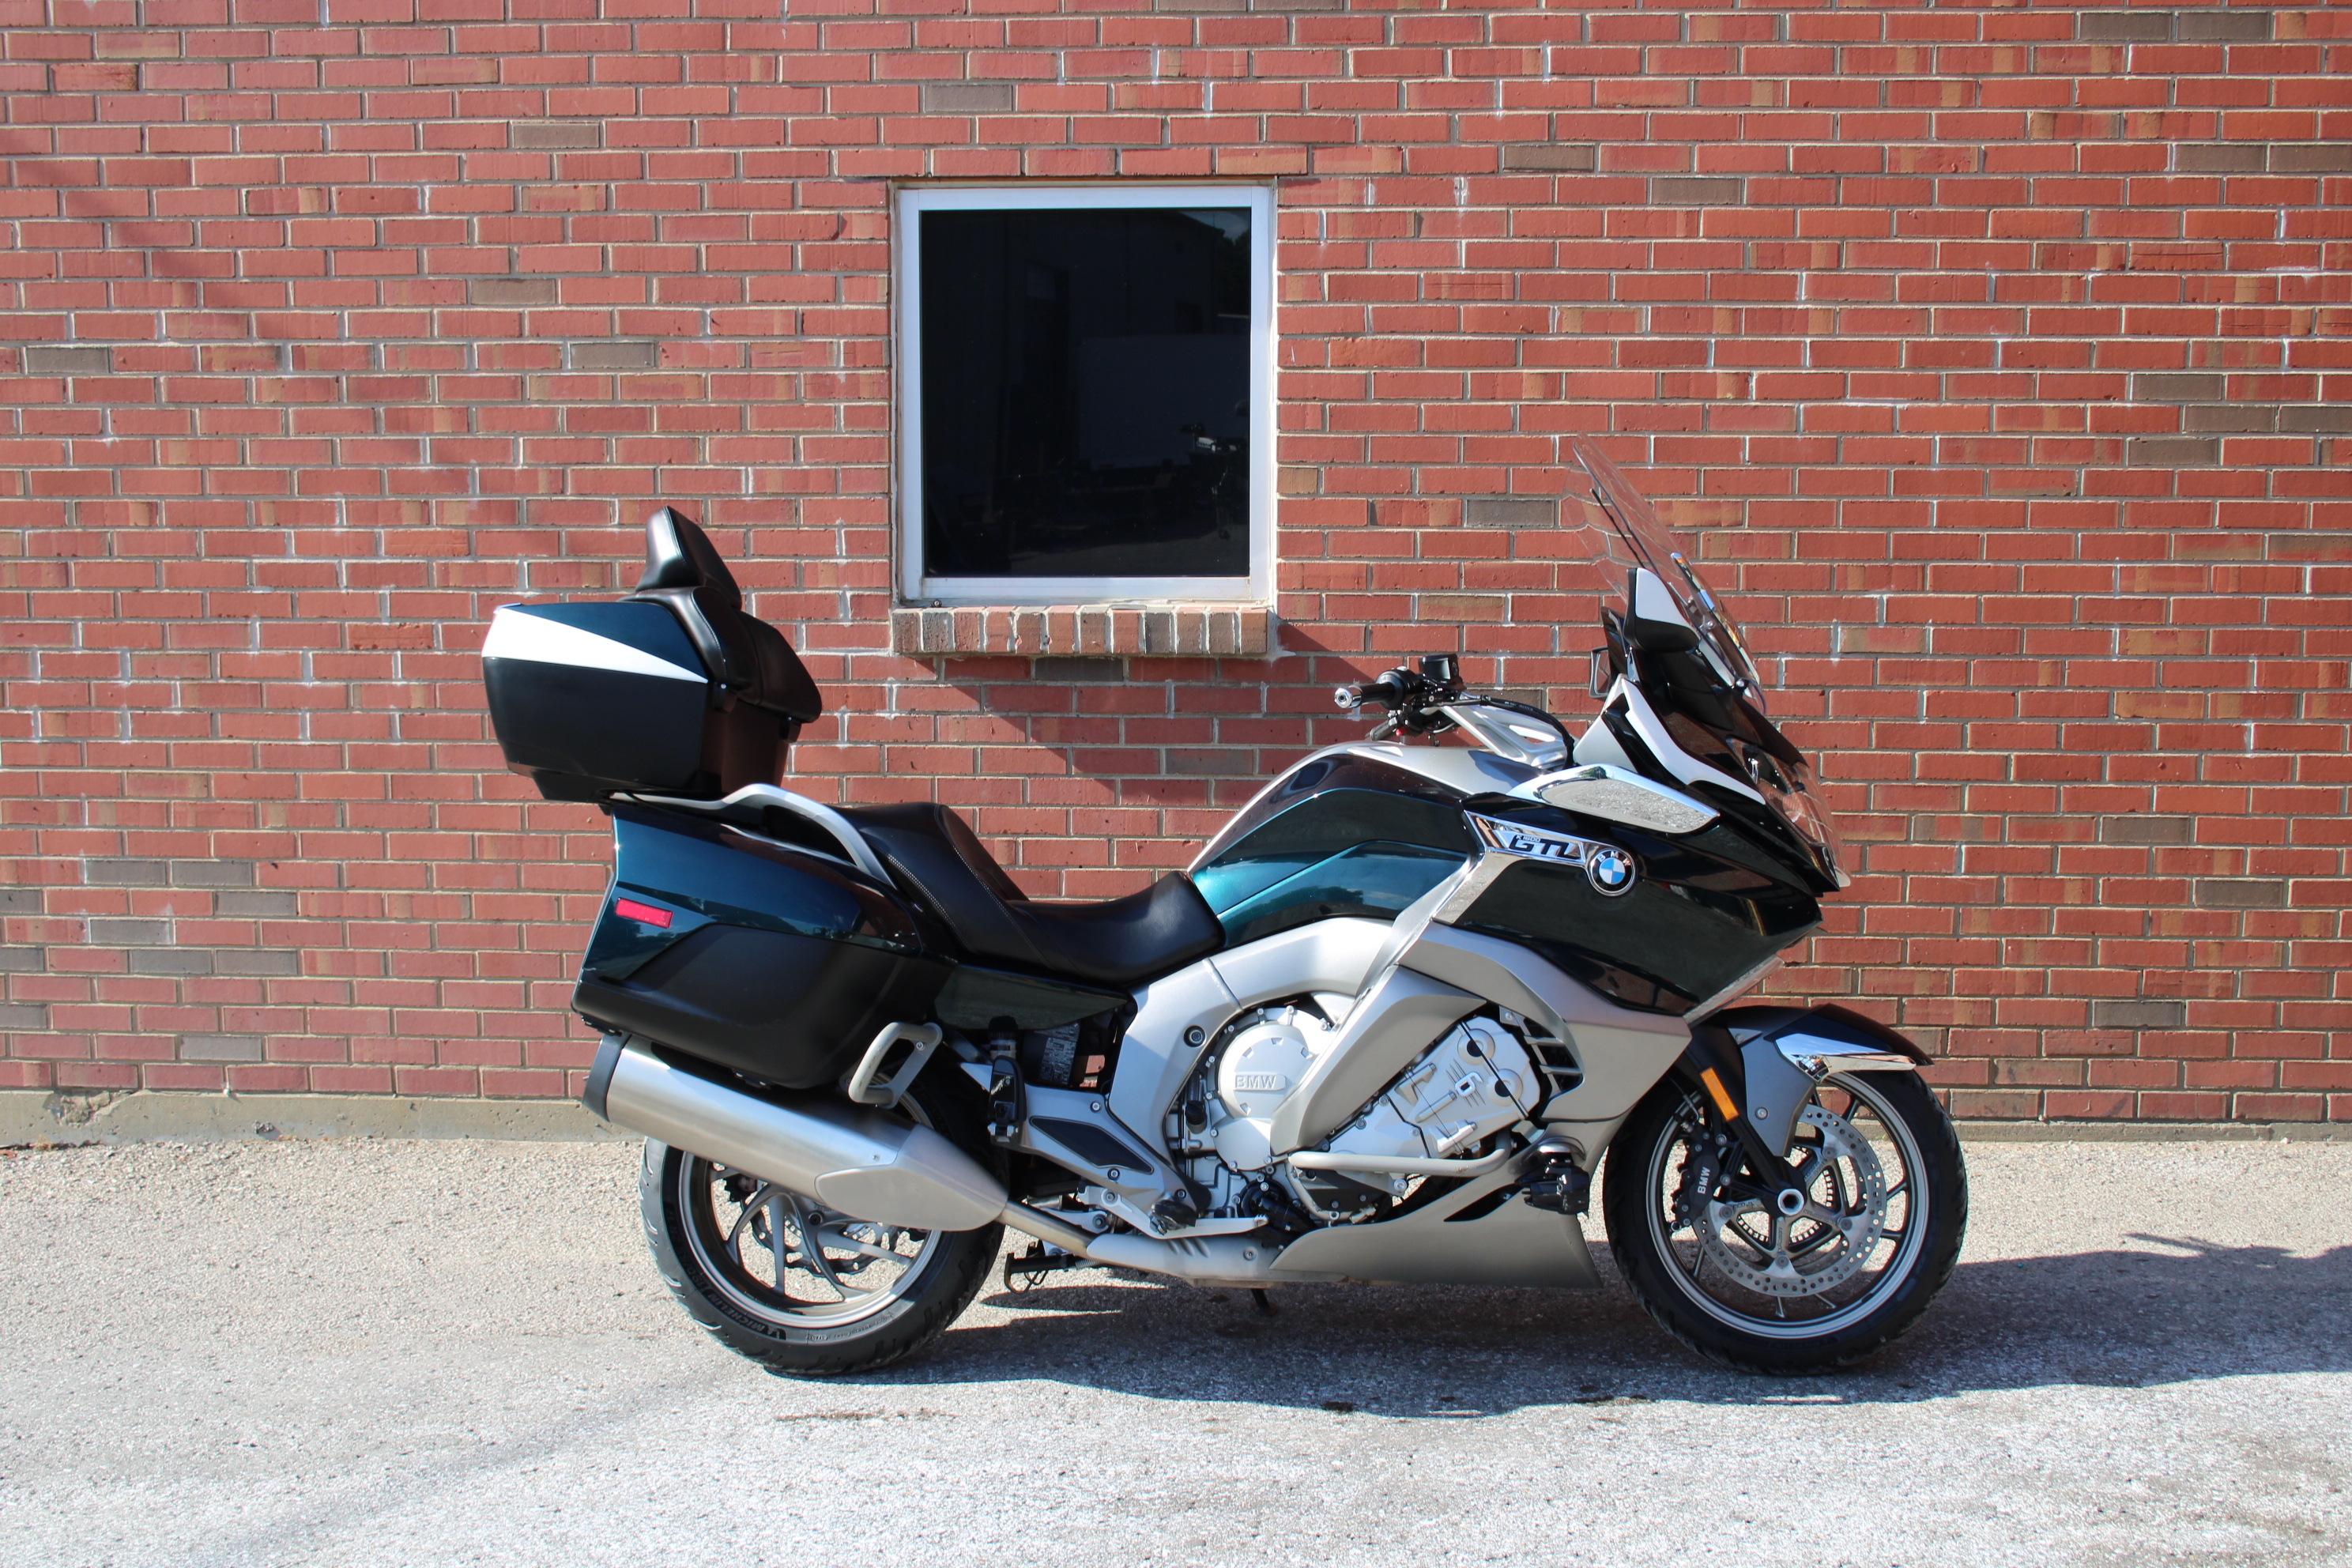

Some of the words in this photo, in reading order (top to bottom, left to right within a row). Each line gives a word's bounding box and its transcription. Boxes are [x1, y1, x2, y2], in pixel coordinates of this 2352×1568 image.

[1509, 835, 1581, 860] GTL
[1236, 1075, 1277, 1089] BMW
[1697, 1167, 1710, 1194] BMW
[707, 1293, 766, 1332] MICHELIN
